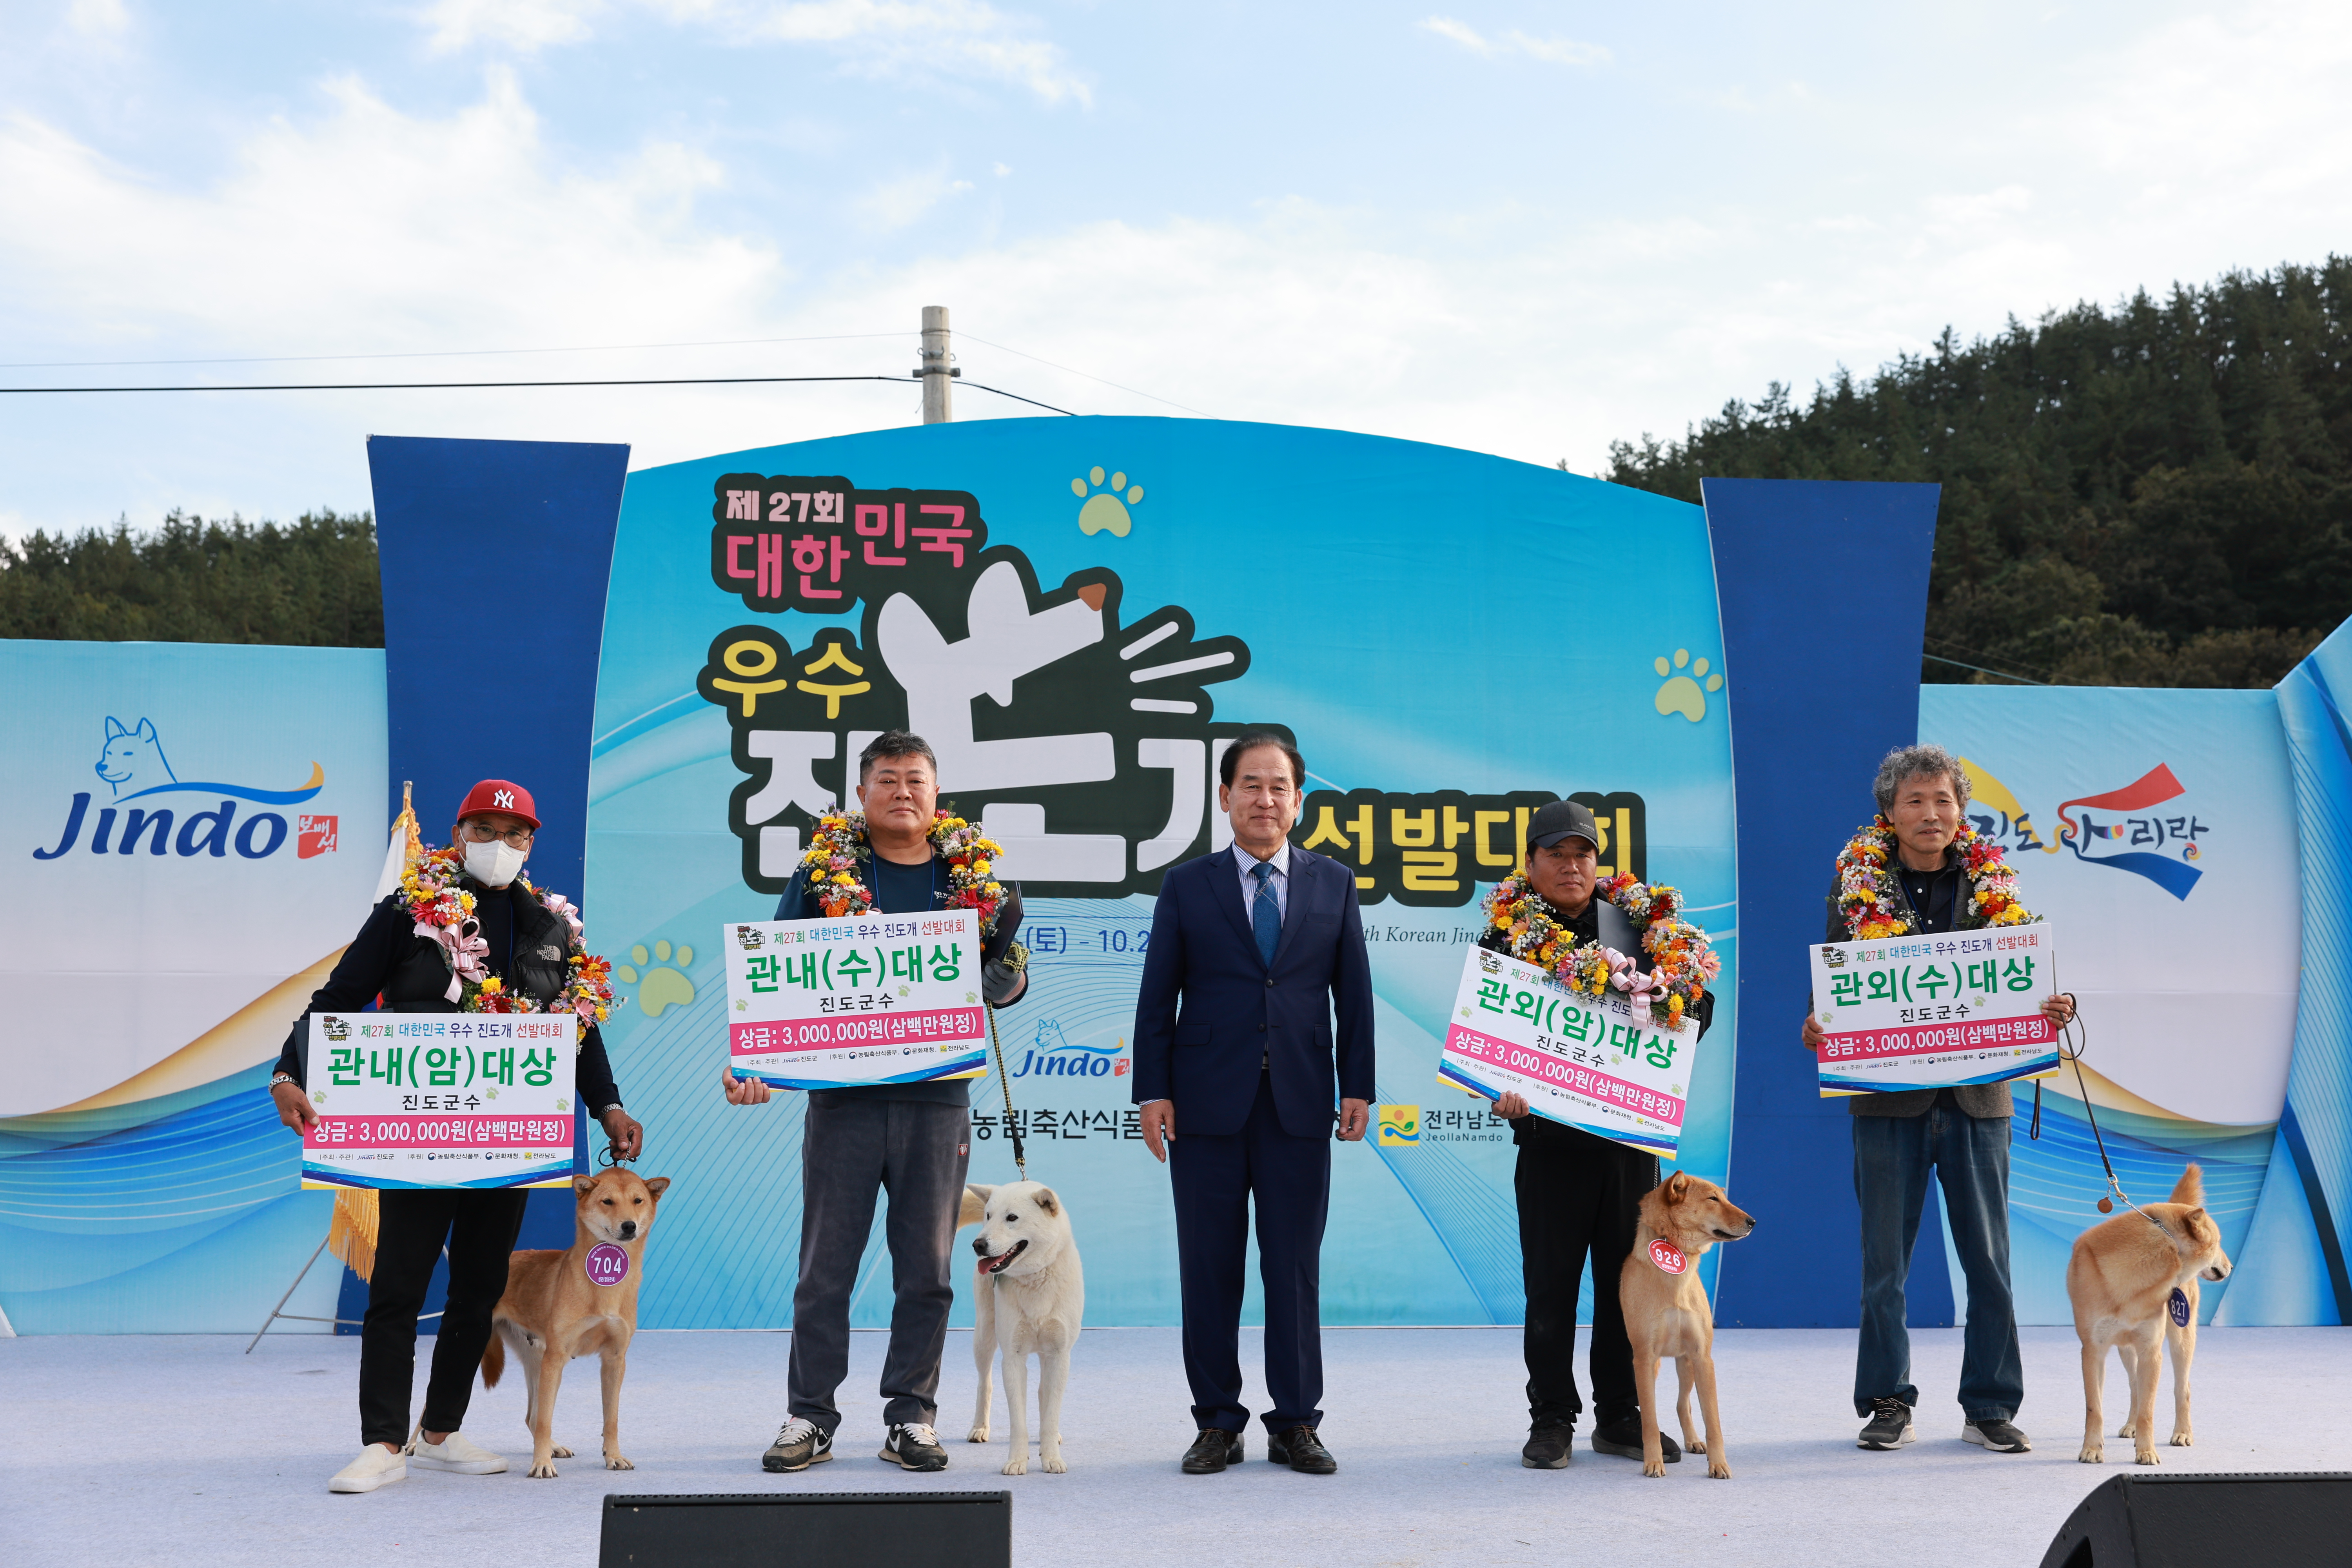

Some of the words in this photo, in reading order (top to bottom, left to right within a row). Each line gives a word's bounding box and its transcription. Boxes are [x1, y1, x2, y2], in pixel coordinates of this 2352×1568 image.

[726, 490, 759, 521] 제
[769, 491, 844, 523] 27회
[727, 503, 973, 599] 대한민국
[712, 640, 871, 719] 우수
[493, 789, 514, 809] NY
[33, 792, 288, 860] Jindo
[774, 931, 805, 945] 제27회
[810, 926, 854, 941] 대한민국
[858, 924, 880, 940] 우수
[884, 922, 917, 938] 진도개
[921, 919, 965, 936] 선발대회
[1099, 930, 1151, 952] 10.2
[1385, 927, 1446, 942] Korean
[1857, 949, 1885, 962] 제27회
[1890, 944, 1931, 958] 대한민국
[1936, 941, 1956, 956] 우수
[1961, 938, 1992, 953] 진도개
[1996, 933, 2038, 950] 선발대회
[746, 943, 962, 993] 관내(수)대상
[1831, 956, 2034, 1006] 관외(수)대상
[1510, 968, 1539, 986] 제27회
[1543, 980, 1573, 996] 대한민
[1612, 1000, 1631, 1016] 진도
[361, 1025, 393, 1038] 제27회
[399, 1023, 445, 1036] 대한민국
[450, 1023, 472, 1038] 우수
[478, 1023, 512, 1038] 진도개
[516, 1023, 562, 1038] 선발대회
[739, 1027, 777, 1049] 상금:
[782, 1012, 976, 1046] 3,000,000원(삼백만원정)
[1477, 978, 1677, 1069] 관외(암)대상
[1825, 1037, 1861, 1056] 상금:
[1866, 1019, 2049, 1053] 3,000,000원(삼백만원정)
[328, 1045, 556, 1088] 관내(암)대상
[1013, 1050, 1111, 1077] Jindo
[1455, 1031, 1491, 1055] 상금:
[1495, 1045, 1676, 1120] 3,000,000원(삼백만원정)
[1506, 1074, 1523, 1083] 진도군
[1644, 1120, 1665, 1131] 전라남도
[313, 1122, 354, 1142] 상금:
[359, 1120, 566, 1143] 3,000,000원(삼백만원정)
[971, 1109, 1167, 1140] 농림축산식품
[1425, 1110, 1504, 1130] 전라남도
[1426, 1133, 1503, 1142] JeollaNamdo
[594, 1257, 621, 1274] 704
[1655, 1249, 1681, 1267] 926
[2171, 1299, 2185, 1317] 827
